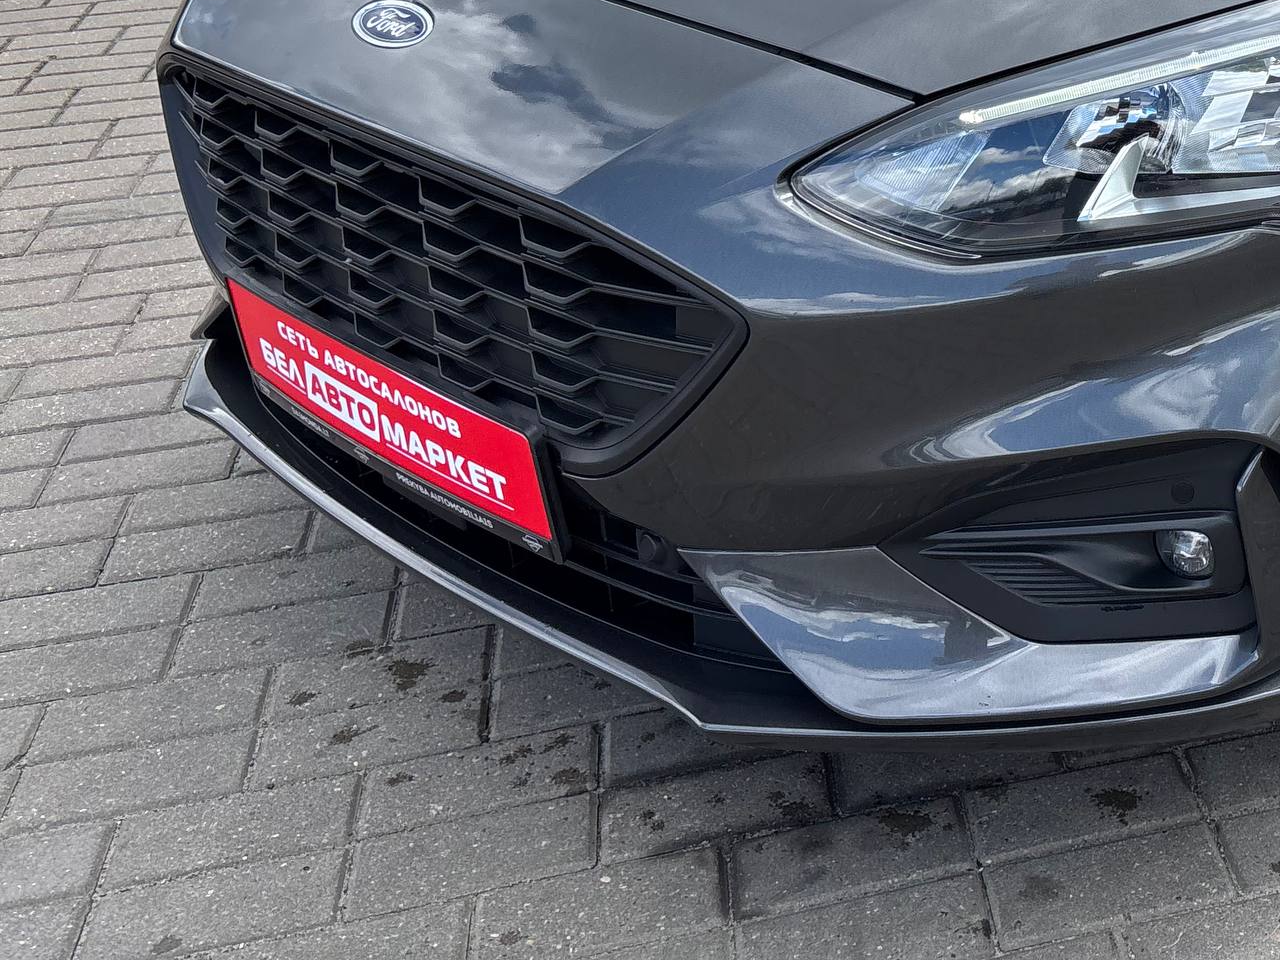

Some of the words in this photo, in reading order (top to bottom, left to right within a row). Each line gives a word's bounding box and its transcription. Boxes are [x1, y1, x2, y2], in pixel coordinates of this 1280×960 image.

[366, 7, 416, 38] Ford
[259, 337, 306, 390] БЕЛ
[310, 371, 377, 433] АВТО
[380, 414, 508, 501] МАРКЕТ
[277, 320, 320, 360] СЕТЬ
[324, 349, 463, 439] АВТОСАЛОНОВ
